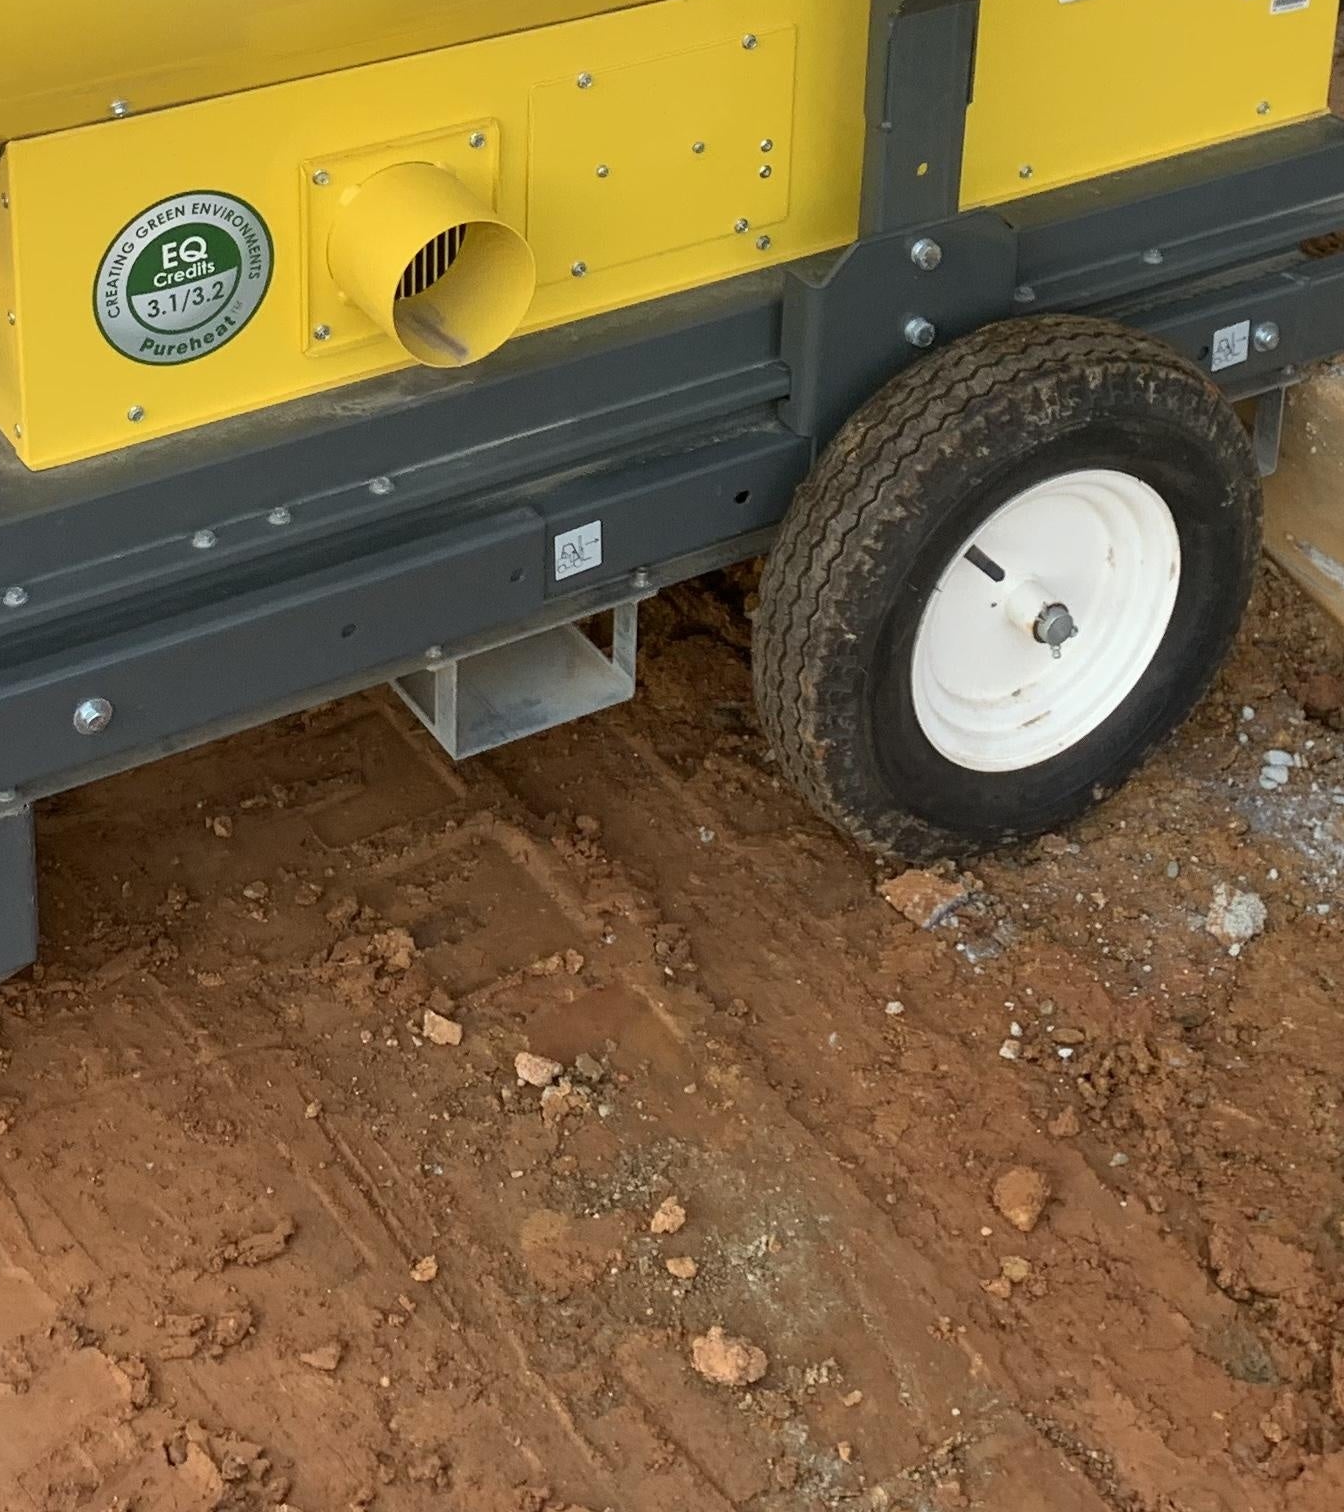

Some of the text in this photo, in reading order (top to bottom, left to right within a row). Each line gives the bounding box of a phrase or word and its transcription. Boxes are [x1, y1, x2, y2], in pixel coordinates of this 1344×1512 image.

[106, 241, 135, 319] CREATING
[135, 204, 186, 239] GREEN
[162, 235, 208, 270] EQ
[153, 260, 216, 288] Credits
[147, 280, 225, 319] 3.1/3.2
[139, 314, 237, 356] Pureheat
